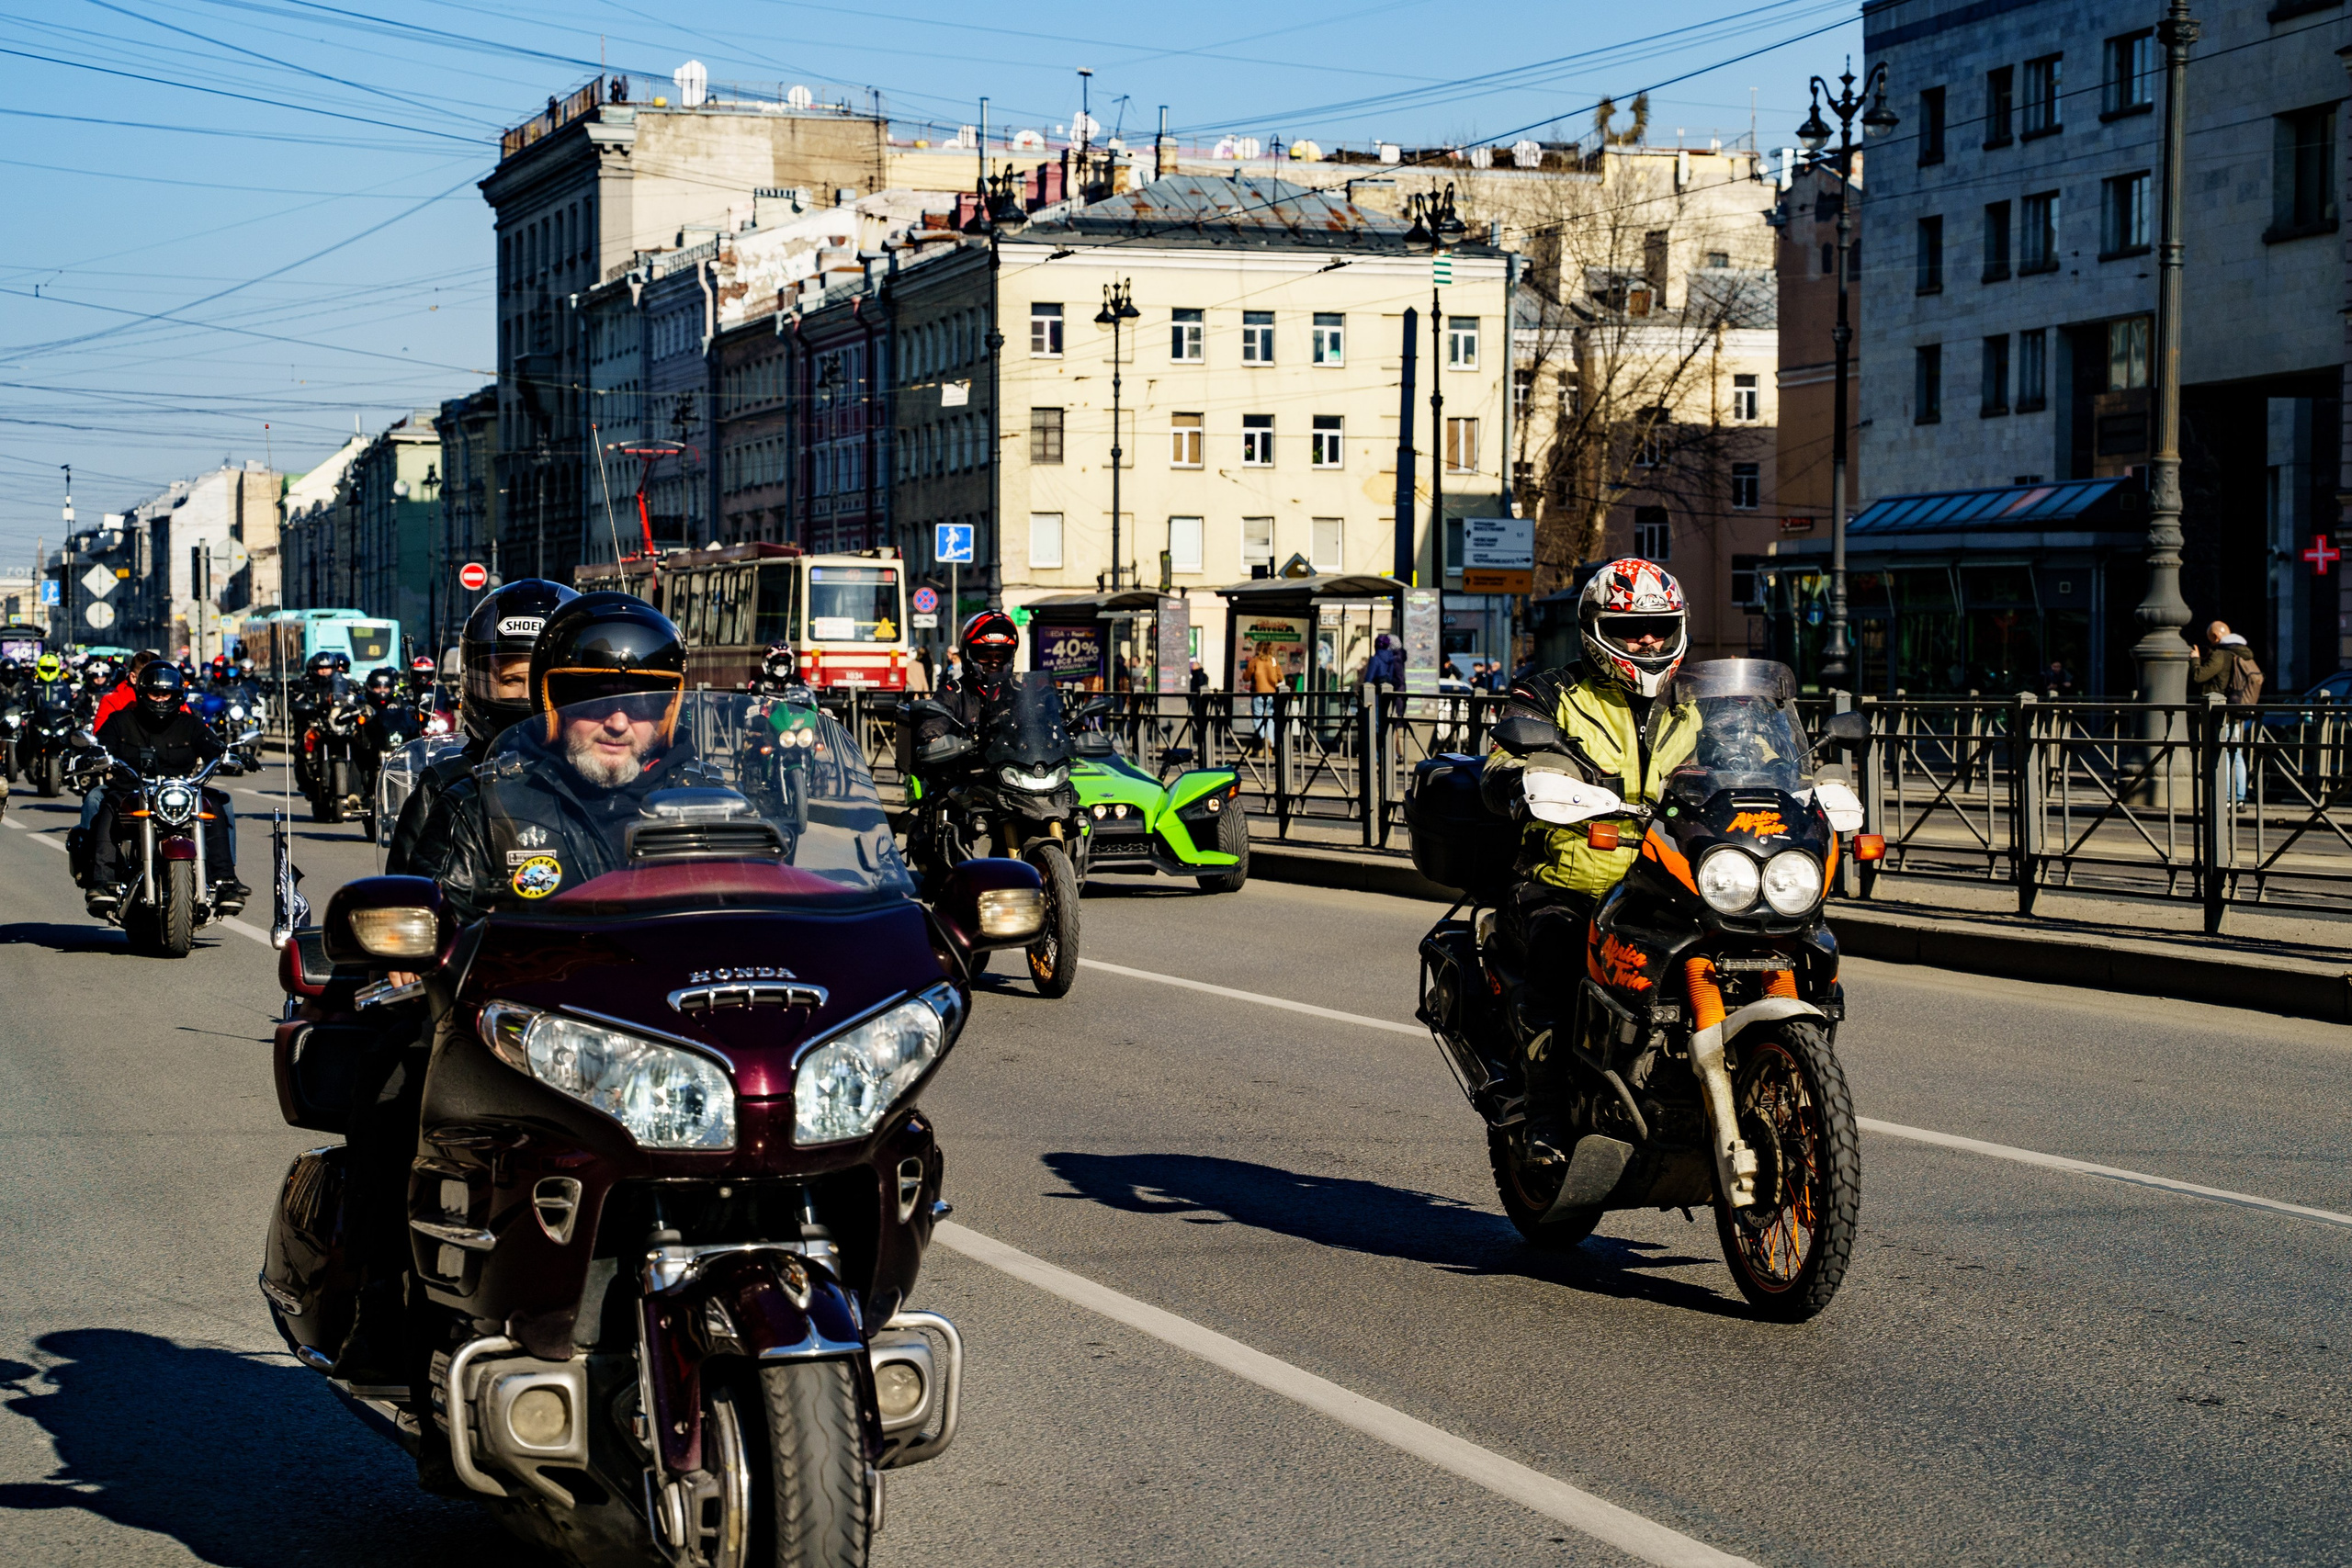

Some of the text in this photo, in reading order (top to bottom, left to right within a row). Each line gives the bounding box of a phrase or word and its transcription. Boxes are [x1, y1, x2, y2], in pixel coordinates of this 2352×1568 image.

[506, 621, 542, 631] SHOEI
[1044, 638, 1099, 658] -40%
[689, 967, 797, 983] HONDA
